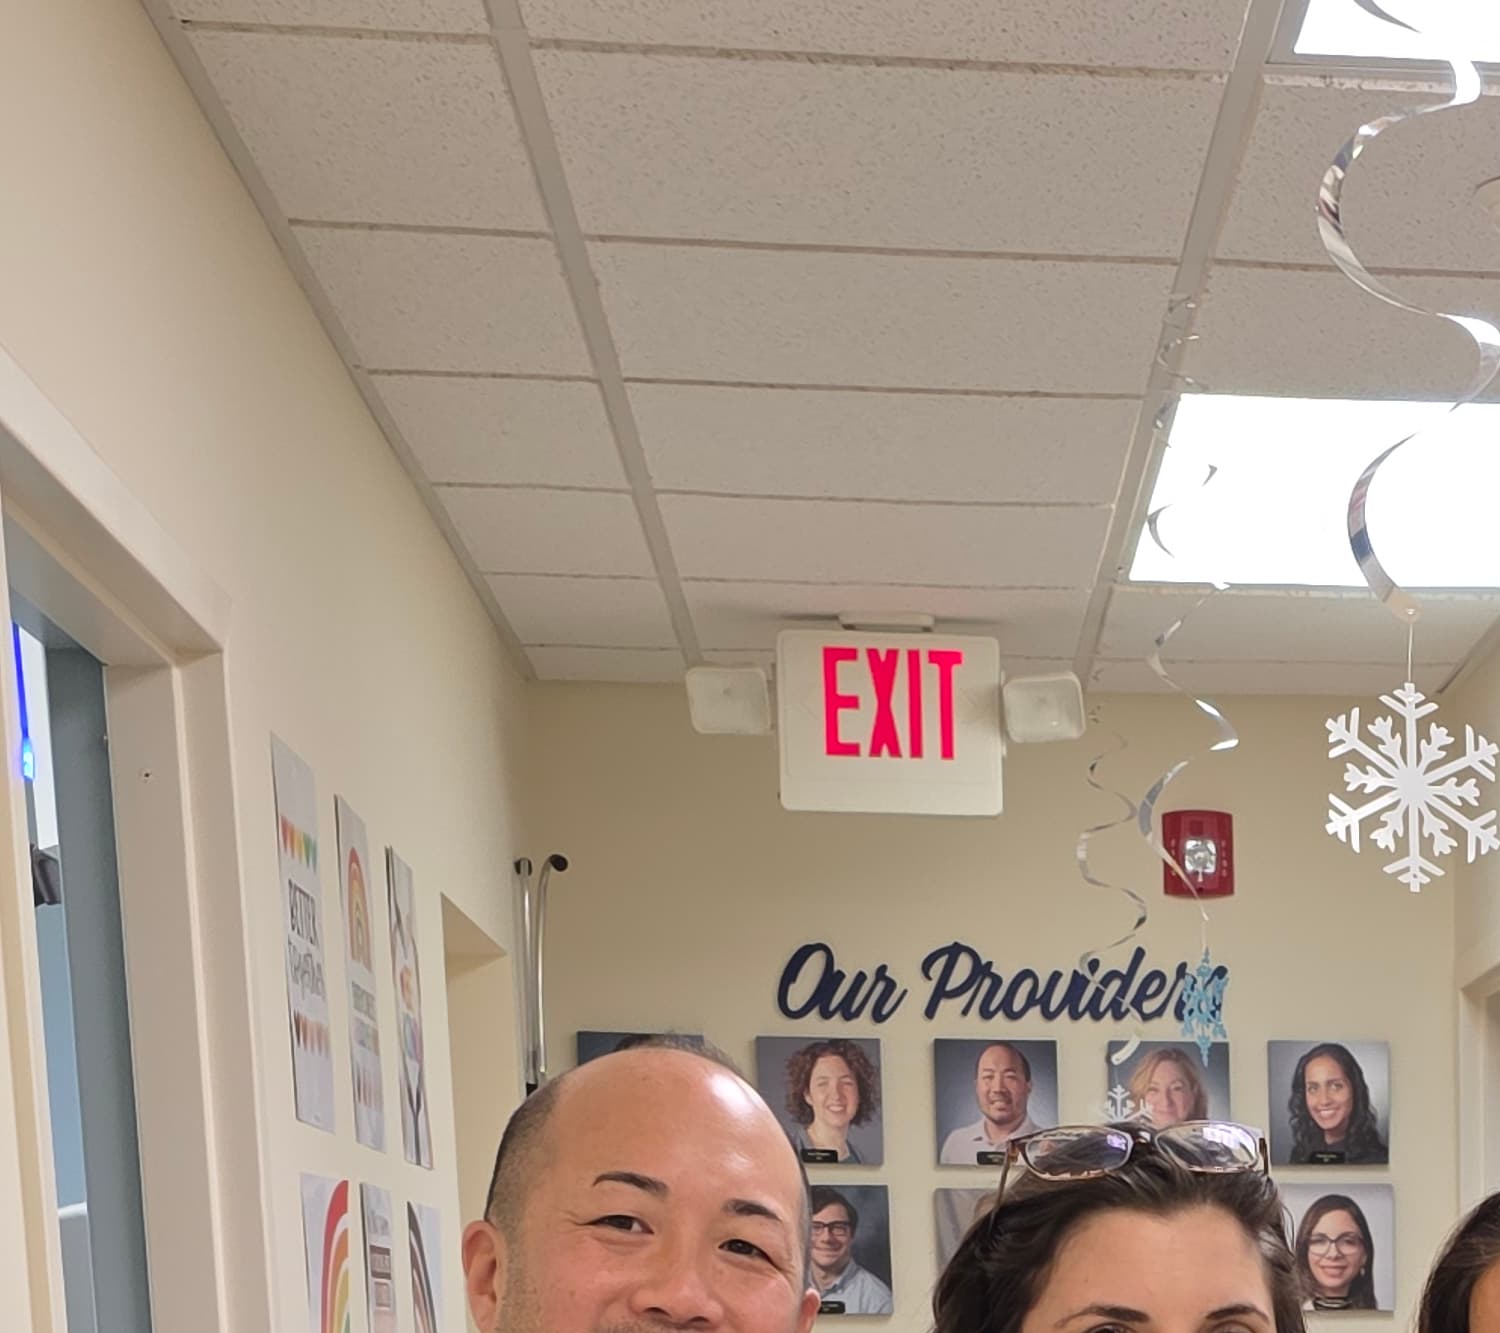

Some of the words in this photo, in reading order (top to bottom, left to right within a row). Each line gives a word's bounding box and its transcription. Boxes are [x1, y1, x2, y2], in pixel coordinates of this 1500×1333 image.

[821, 645, 964, 761] EXIT
[778, 942, 908, 1023] Our
[922, 941, 1229, 1023] Provider
